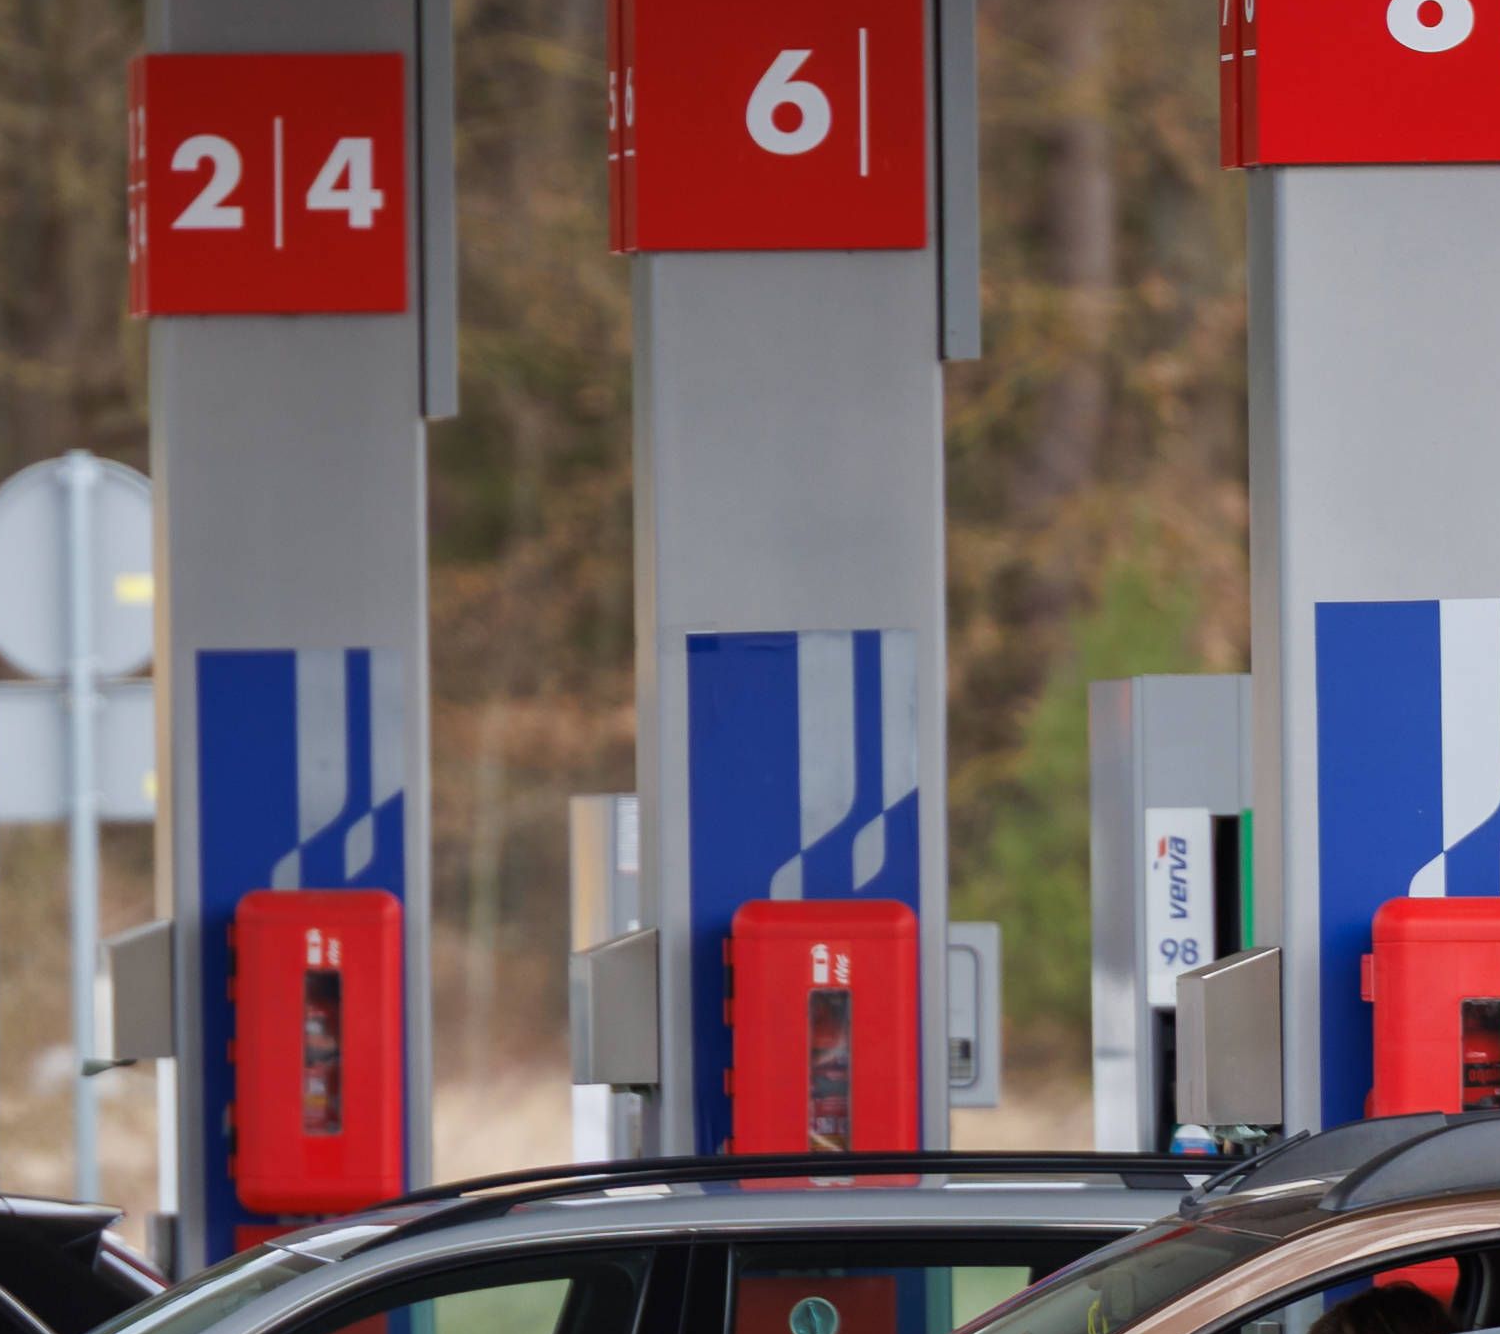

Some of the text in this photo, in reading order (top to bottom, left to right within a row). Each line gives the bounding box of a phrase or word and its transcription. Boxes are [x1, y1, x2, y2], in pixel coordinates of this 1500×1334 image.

[745, 48, 832, 156] 6
[170, 133, 385, 230] 2 4
[1168, 836, 1189, 919] verva
[1159, 937, 1199, 966] 98
